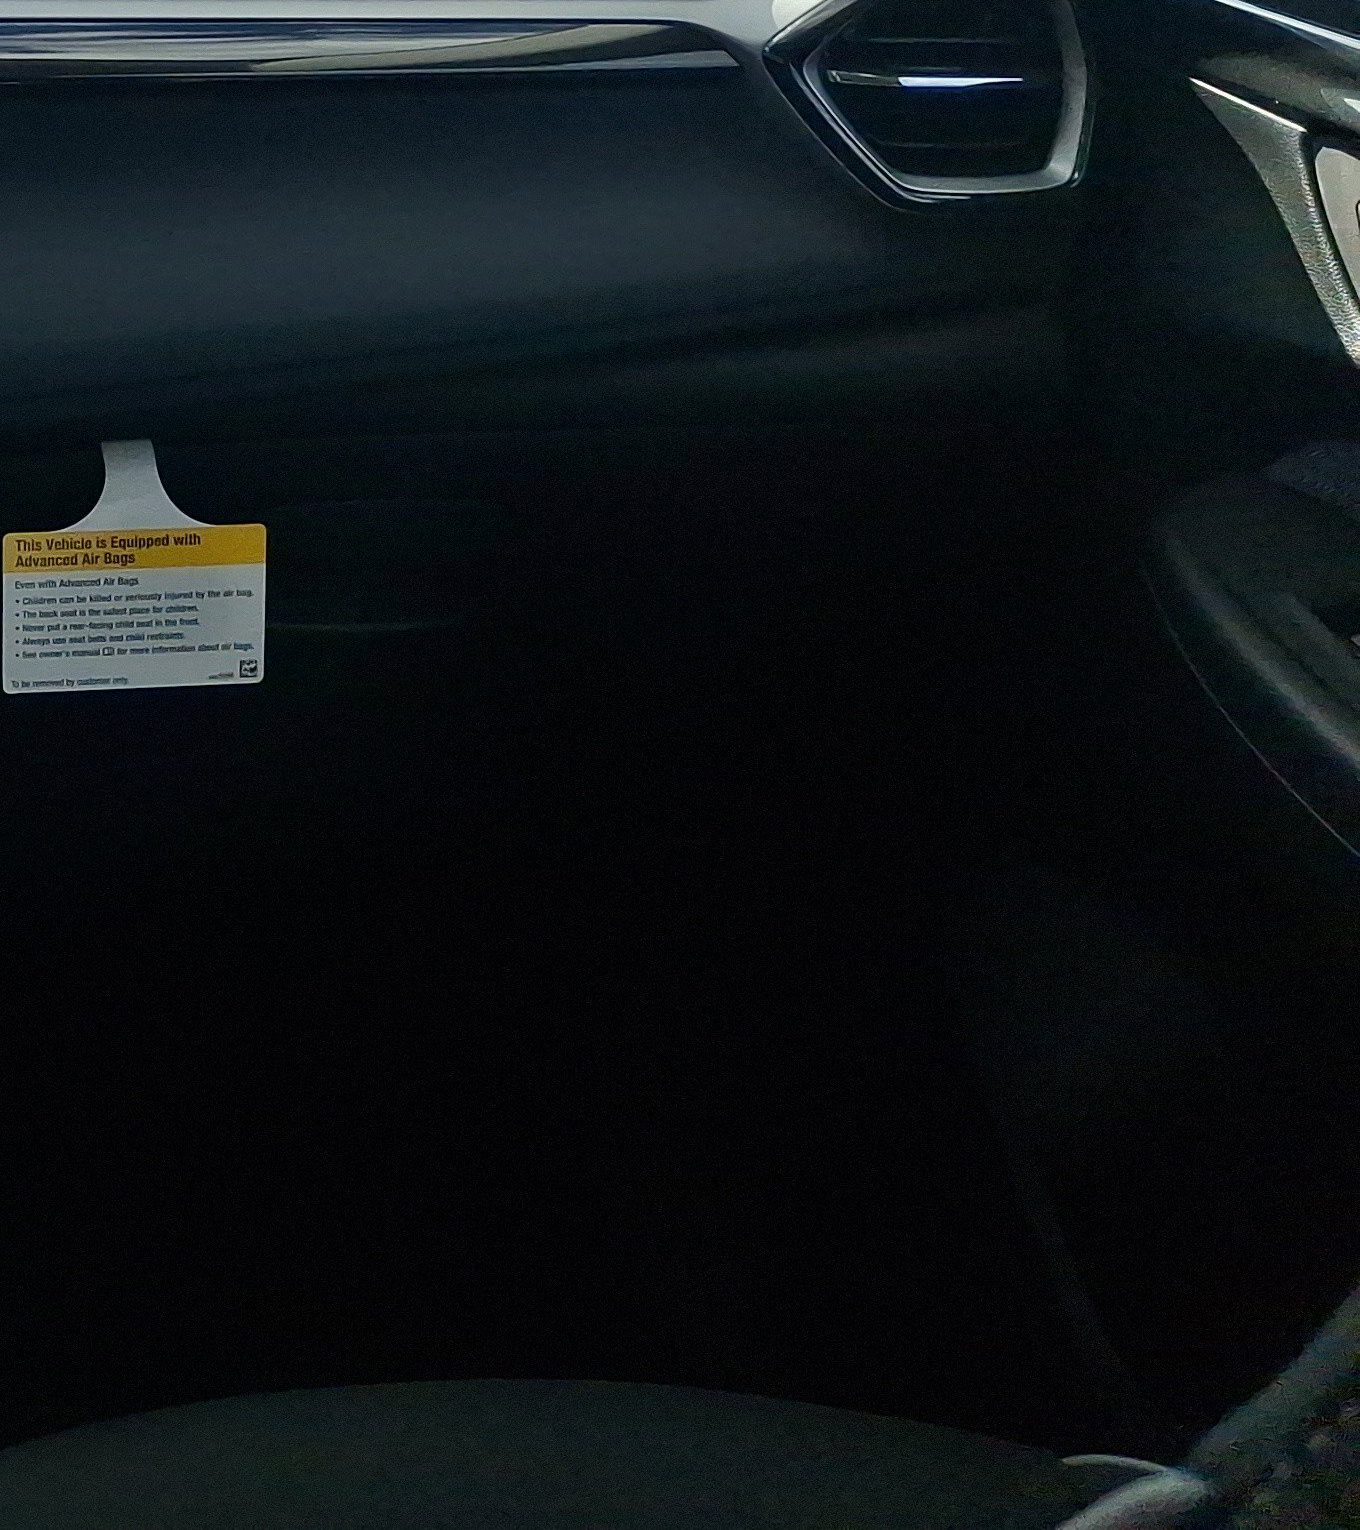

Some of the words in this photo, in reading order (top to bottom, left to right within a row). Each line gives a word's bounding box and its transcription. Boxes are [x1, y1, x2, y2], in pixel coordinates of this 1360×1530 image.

[15, 539, 42, 552] This
[46, 537, 92, 551] Vehicle
[96, 536, 108, 549] is
[111, 533, 170, 550] Equipped
[173, 532, 202, 546] with
[15, 553, 78, 568] Advanced
[81, 552, 101, 565] Air
[104, 552, 136, 567] Bags
[15, 580, 36, 590] Even
[38, 579, 57, 589] with
[59, 578, 101, 588] Advanced
[103, 577, 115, 587] Air
[117, 576, 139, 587] Bags
[22, 596, 57, 605] Children
[59, 596, 75, 604] can
[76, 595, 87, 604] be
[89, 594, 112, 603] killed
[164, 591, 193, 601] injured
